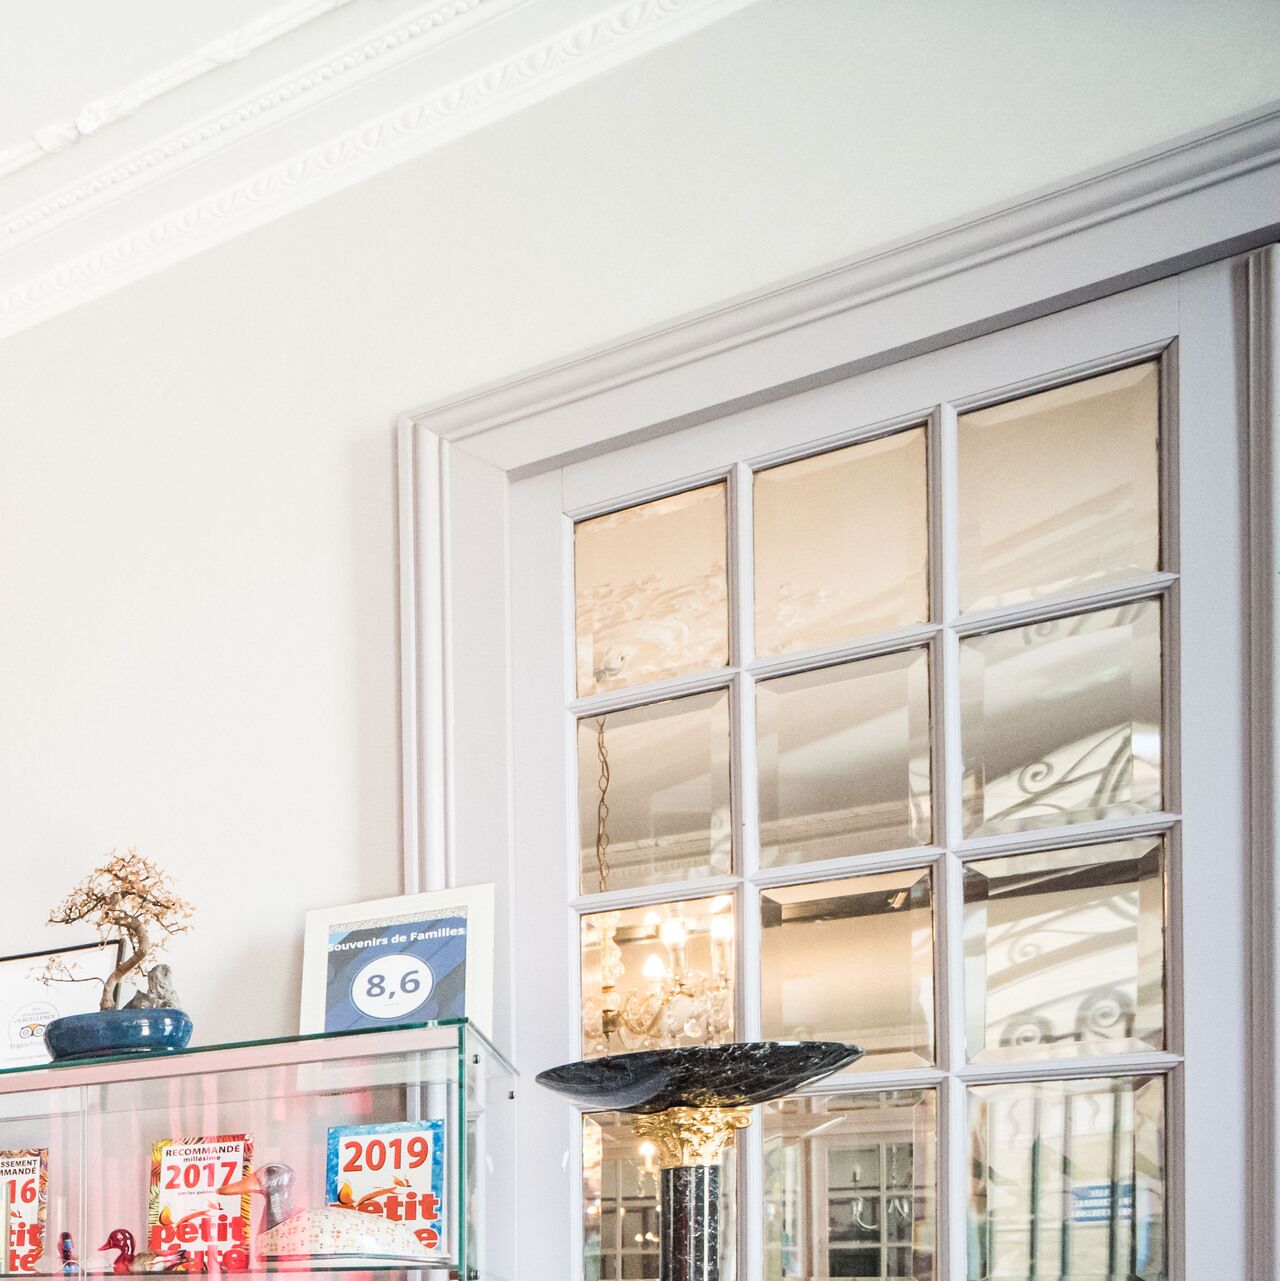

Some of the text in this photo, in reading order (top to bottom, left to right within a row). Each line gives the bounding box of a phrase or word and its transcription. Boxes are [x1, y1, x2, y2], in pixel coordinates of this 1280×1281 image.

[328, 926, 466, 952] Souvenirs de Familles
[365, 969, 421, 999] 8,6
[165, 1144, 241, 1157] RECOMMANDÉ
[342, 1136, 429, 1172] 2019
[164, 1161, 238, 1190] 2017
[329, 1192, 439, 1221] etit
[148, 1213, 248, 1250] petit
